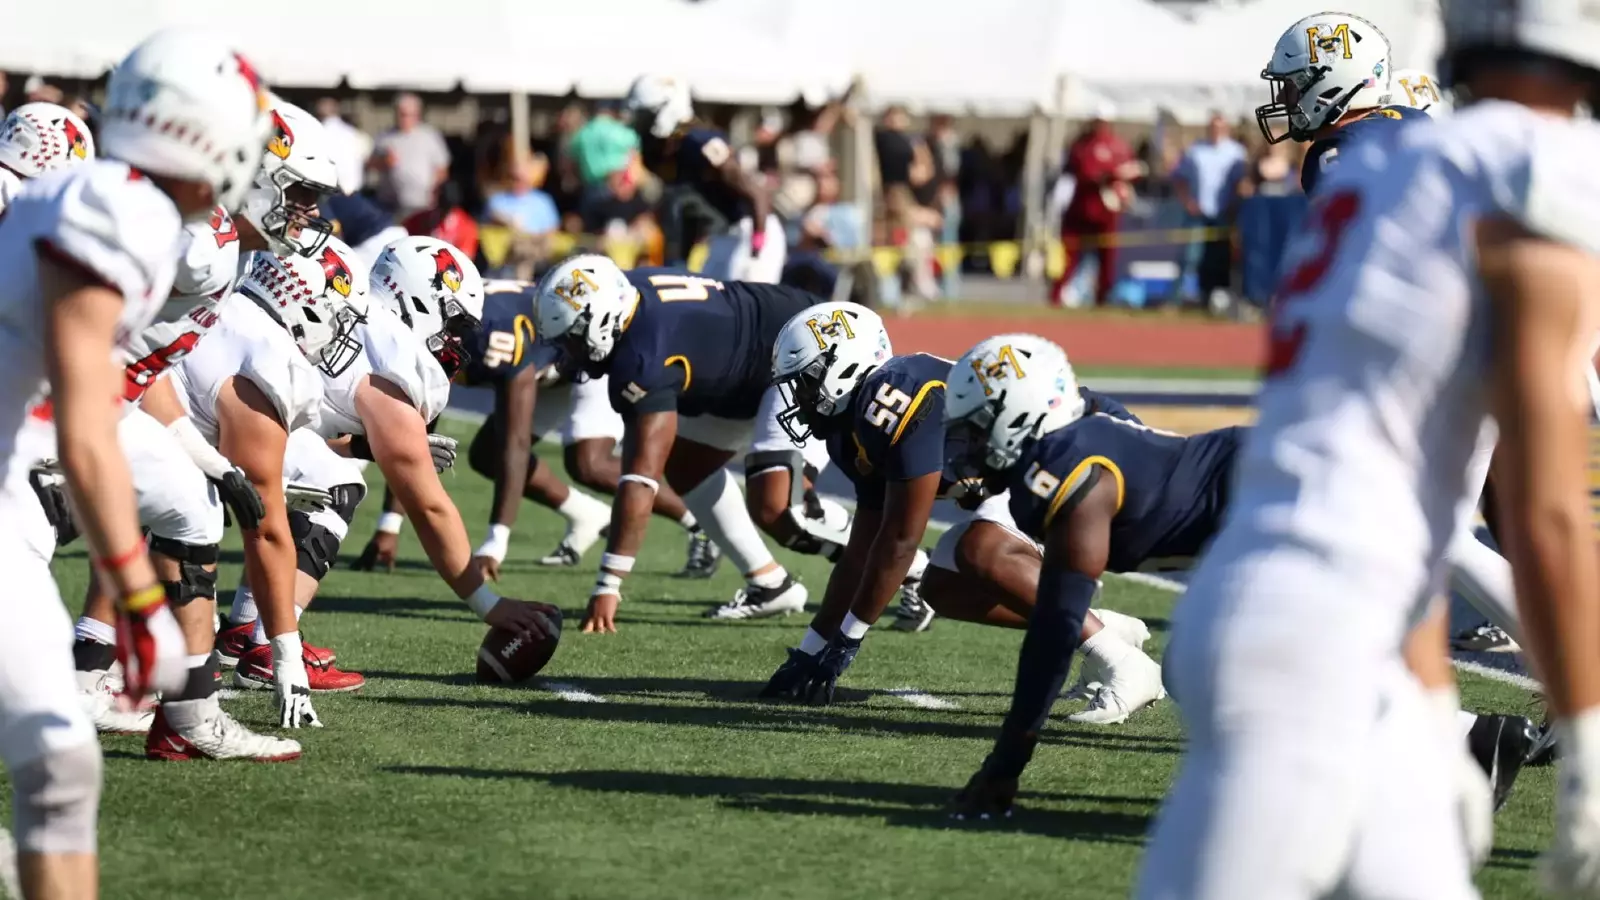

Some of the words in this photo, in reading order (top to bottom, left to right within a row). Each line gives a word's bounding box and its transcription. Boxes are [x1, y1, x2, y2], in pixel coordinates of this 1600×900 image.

[648, 275, 725, 302] 4
[483, 331, 515, 368] 40
[621, 381, 648, 404] 4
[865, 383, 912, 435] 55
[1024, 462, 1060, 499] 6
